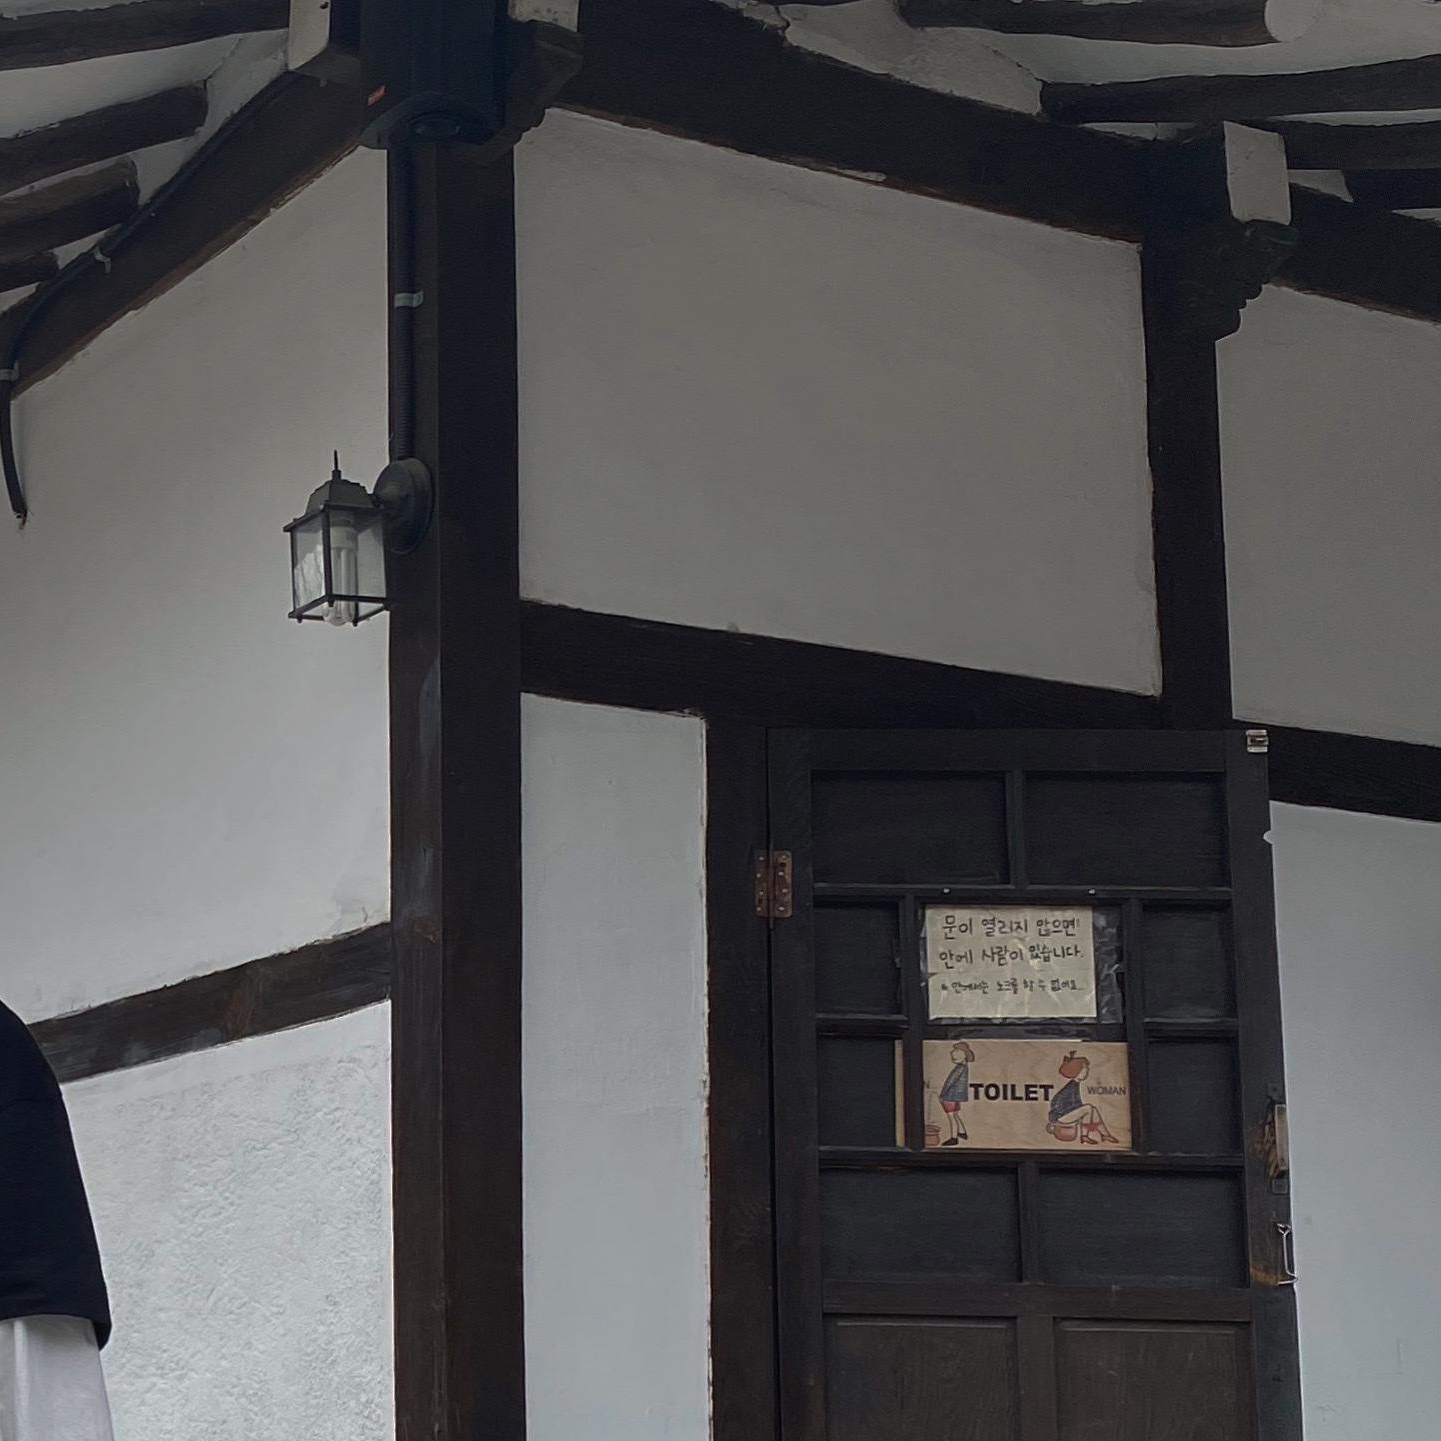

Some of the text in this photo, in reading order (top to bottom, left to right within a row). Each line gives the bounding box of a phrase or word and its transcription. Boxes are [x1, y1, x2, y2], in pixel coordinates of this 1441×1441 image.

[942, 914, 1077, 940] 문이 열리지 않으면
[939, 949, 973, 969] 안에
[981, 945, 1024, 967] 사람이
[969, 1083, 1126, 1101] TOILET WOMAN
